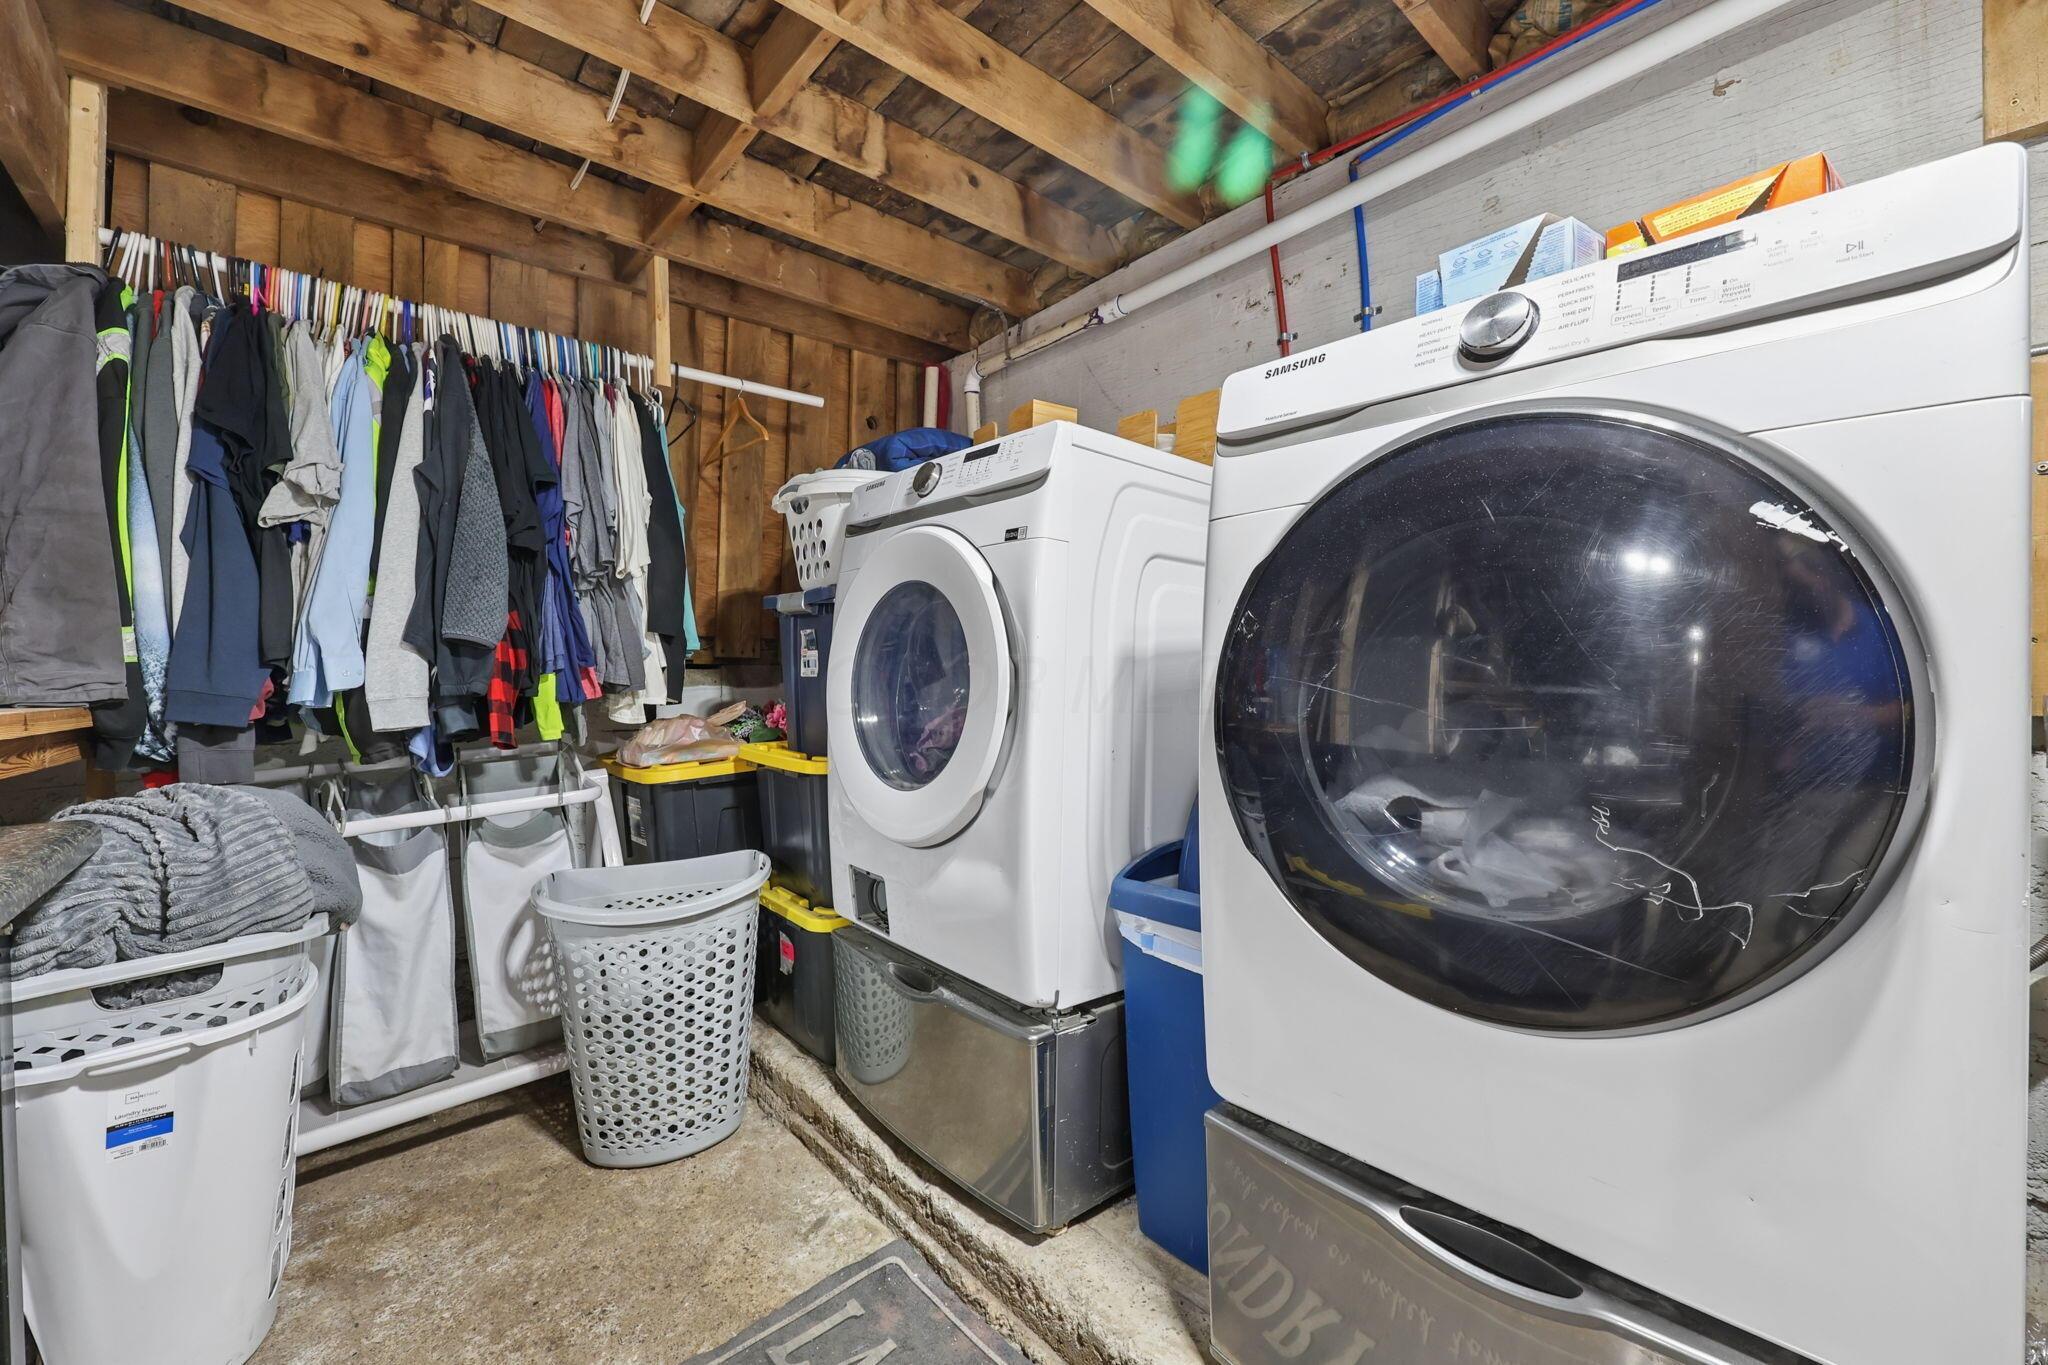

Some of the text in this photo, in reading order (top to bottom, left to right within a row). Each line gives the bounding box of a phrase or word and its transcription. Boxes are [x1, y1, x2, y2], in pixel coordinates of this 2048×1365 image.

[1561, 271, 1596, 286] DELICATES
[1721, 288, 1750, 299] Prevent
[1558, 295, 1593, 308] QUICK DRY
[1562, 305, 1592, 318] TIME DRY
[1614, 311, 1642, 323] Dryness
[1558, 317, 1590, 331] AIR FLUFF
[1264, 353, 1327, 380] SAMSUNG
[866, 480, 886, 492] SAMSUNG
[114, 1109, 141, 1120] Laundry
[141, 1104, 167, 1113] Hamper
